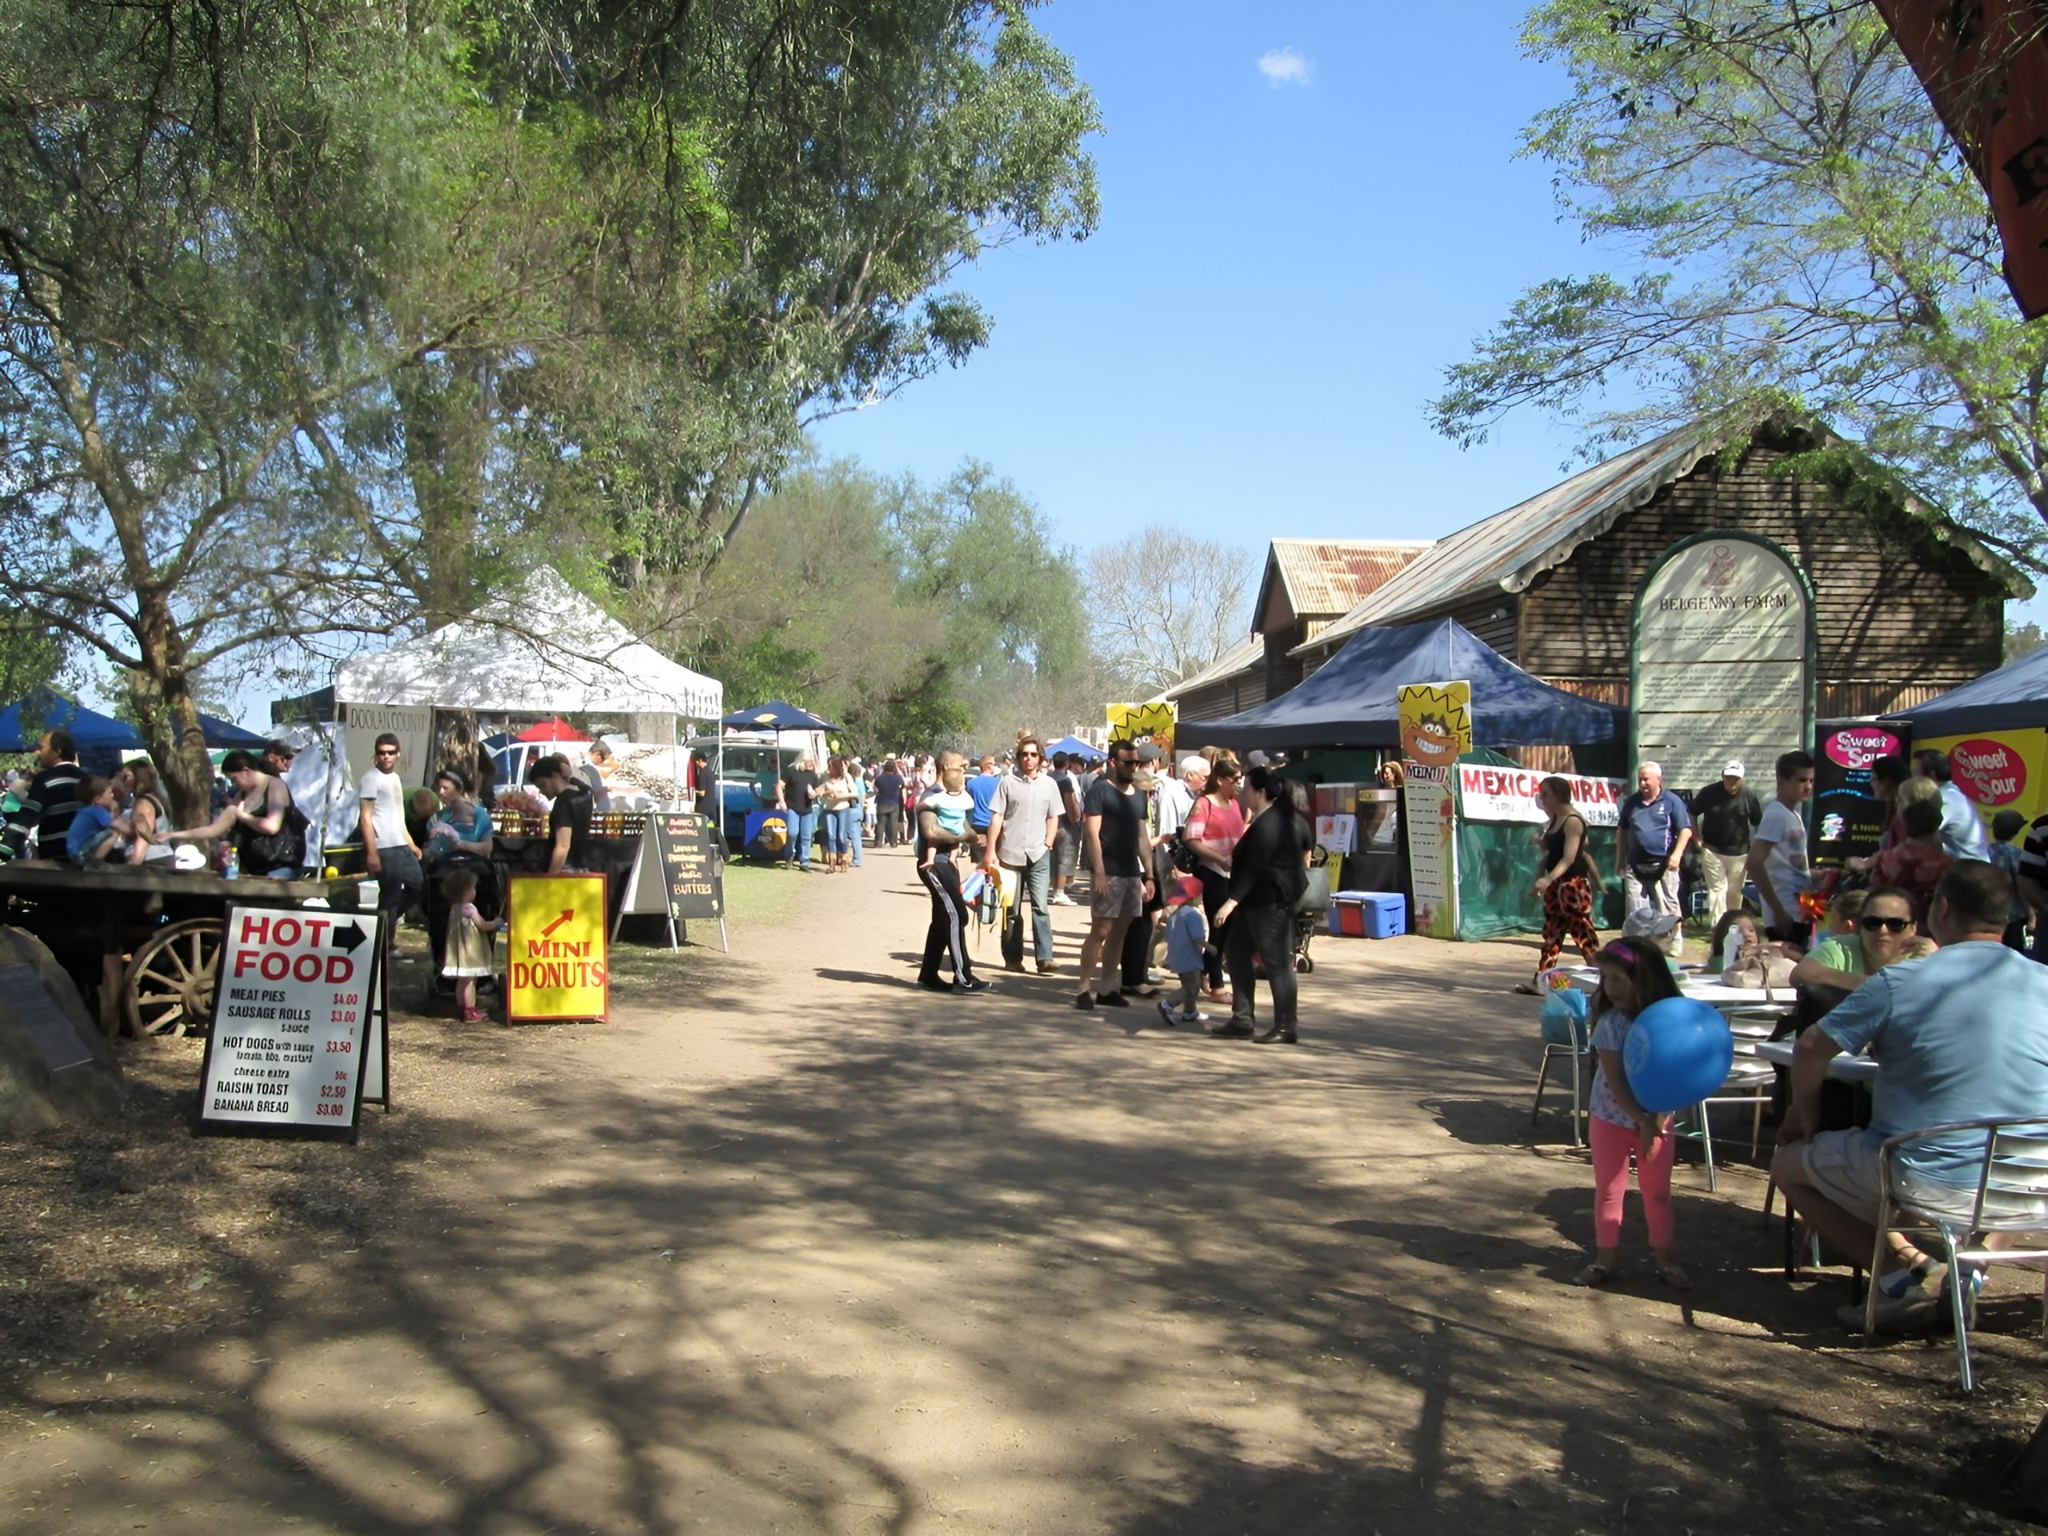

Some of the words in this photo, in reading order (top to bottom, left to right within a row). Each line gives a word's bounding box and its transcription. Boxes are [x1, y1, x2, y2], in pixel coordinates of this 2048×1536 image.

[1660, 596, 1737, 611] BELGENNY
[1744, 594, 1788, 609] FARM
[1837, 731, 1888, 752] Sweet
[1953, 746, 2009, 779] Sweet
[1463, 769, 1542, 798] MEXICA
[1975, 771, 2017, 804] Sour
[240, 915, 331, 948] HOT
[527, 939, 592, 958] MINI
[234, 950, 354, 984] FOOD
[513, 961, 607, 989] DONUTS
[230, 988, 258, 1001] MEAT
[261, 990, 286, 1002] PIES
[227, 1005, 276, 1019] SAUSAGE
[279, 1008, 312, 1021] ROLLS
[281, 1023, 310, 1034] sauce
[223, 1036, 243, 1048] HOT
[246, 1037, 275, 1050] DOGS
[326, 1041, 352, 1053] $3.50
[217, 1081, 254, 1094] RAISIN
[257, 1082, 289, 1096] TOAST
[213, 1098, 254, 1112] BANANA
[257, 1101, 289, 1113] BREAD
